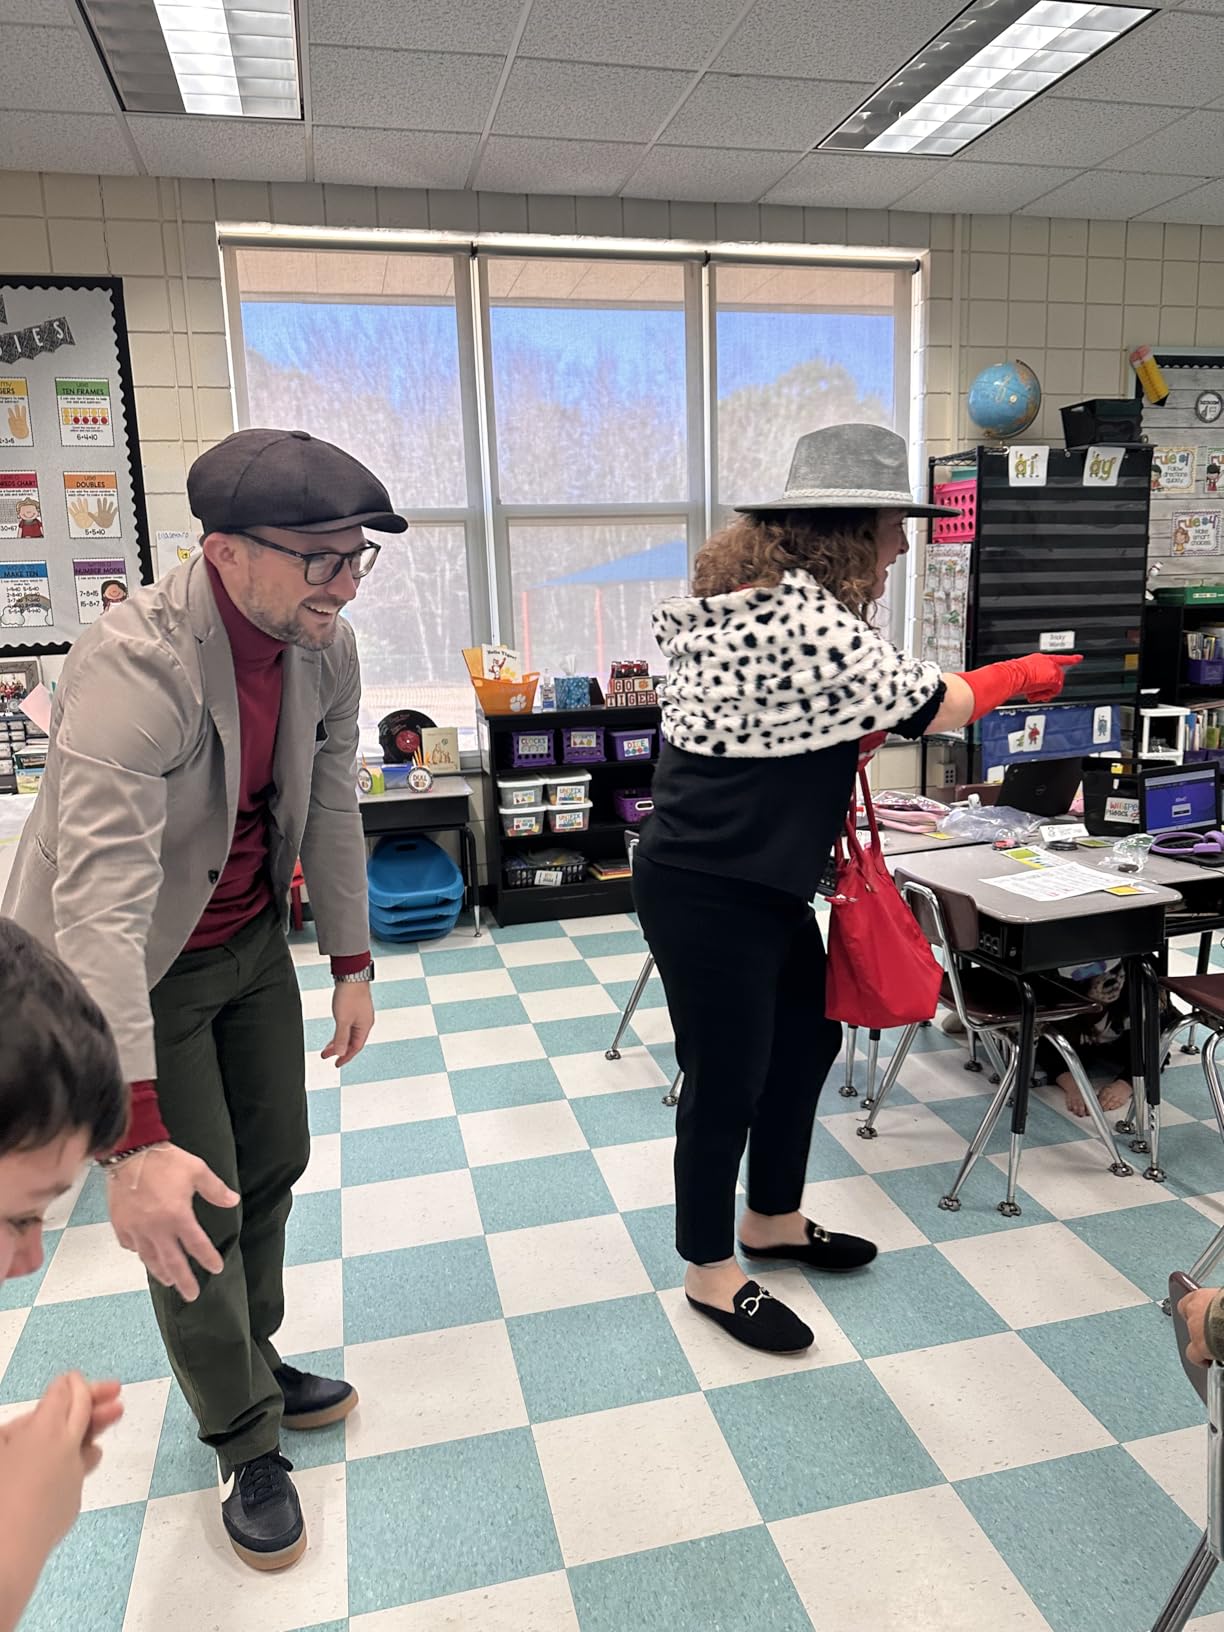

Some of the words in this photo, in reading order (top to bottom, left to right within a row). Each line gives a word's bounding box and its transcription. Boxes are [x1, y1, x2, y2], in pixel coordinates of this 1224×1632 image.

[0, 321, 64, 357] IES
[615, 680, 632, 691] GO
[606, 692, 656, 706] TIGER
[521, 737, 547, 745] CLOCKS
[626, 740, 646, 749] DICE
